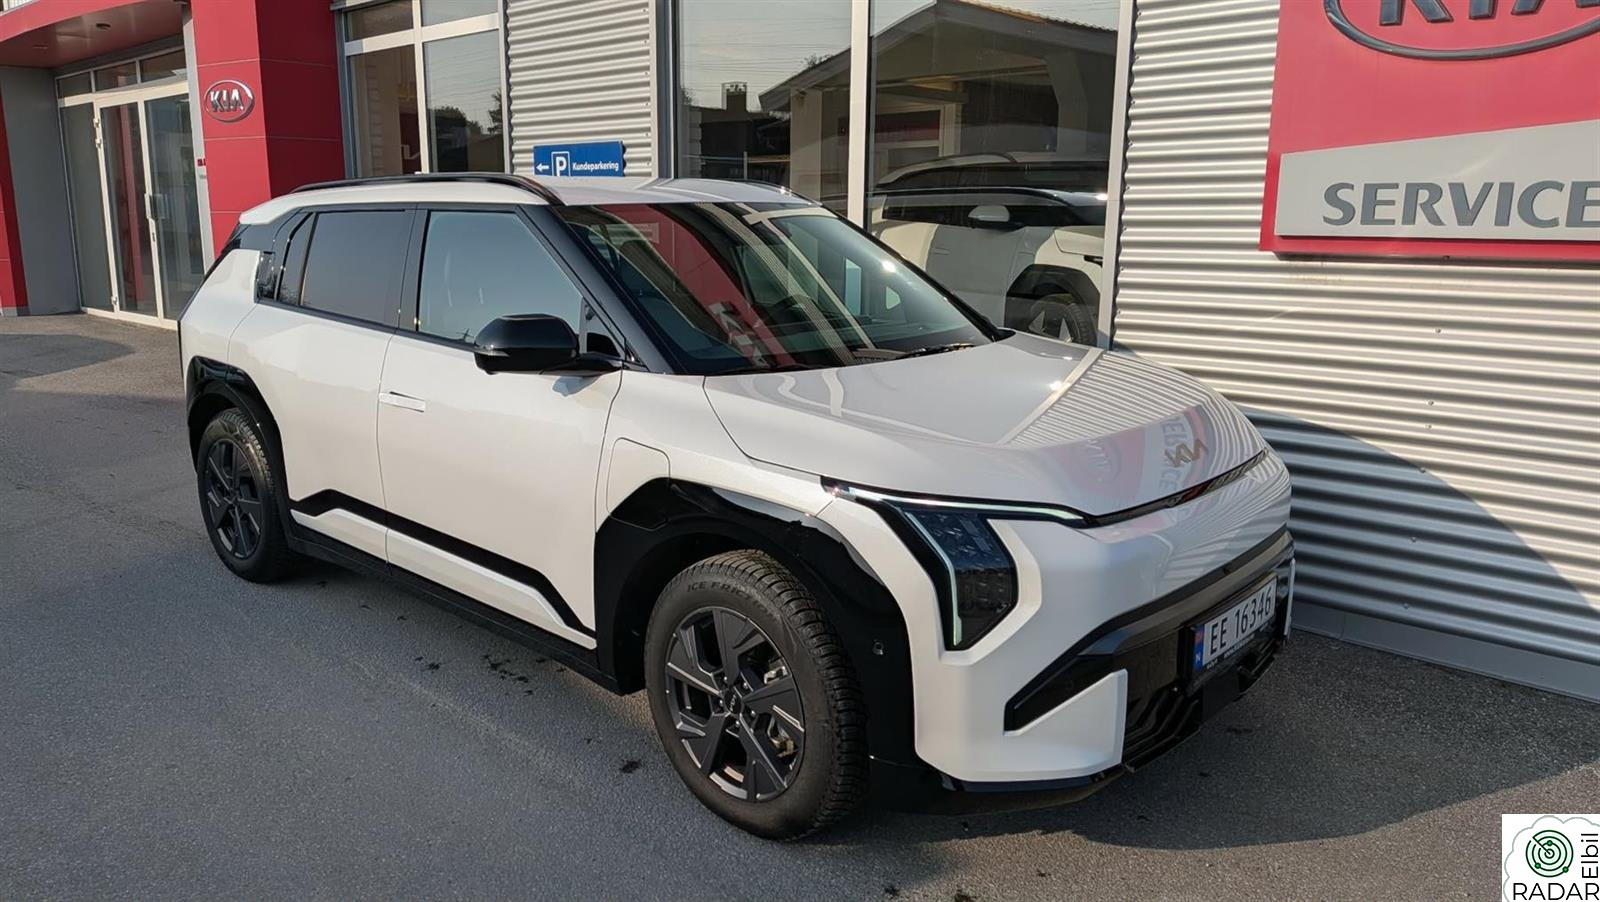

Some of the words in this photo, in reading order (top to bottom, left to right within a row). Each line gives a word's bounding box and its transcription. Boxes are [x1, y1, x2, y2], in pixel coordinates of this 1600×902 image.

[210, 88, 245, 112] KIA
[556, 156, 567, 176] P
[572, 160, 619, 172] Kundeparkering
[1322, 181, 1600, 228] SERVICE
[687, 581, 707, 592] ICE
[1209, 616, 1228, 656] EE
[1235, 586, 1272, 639] 16346
